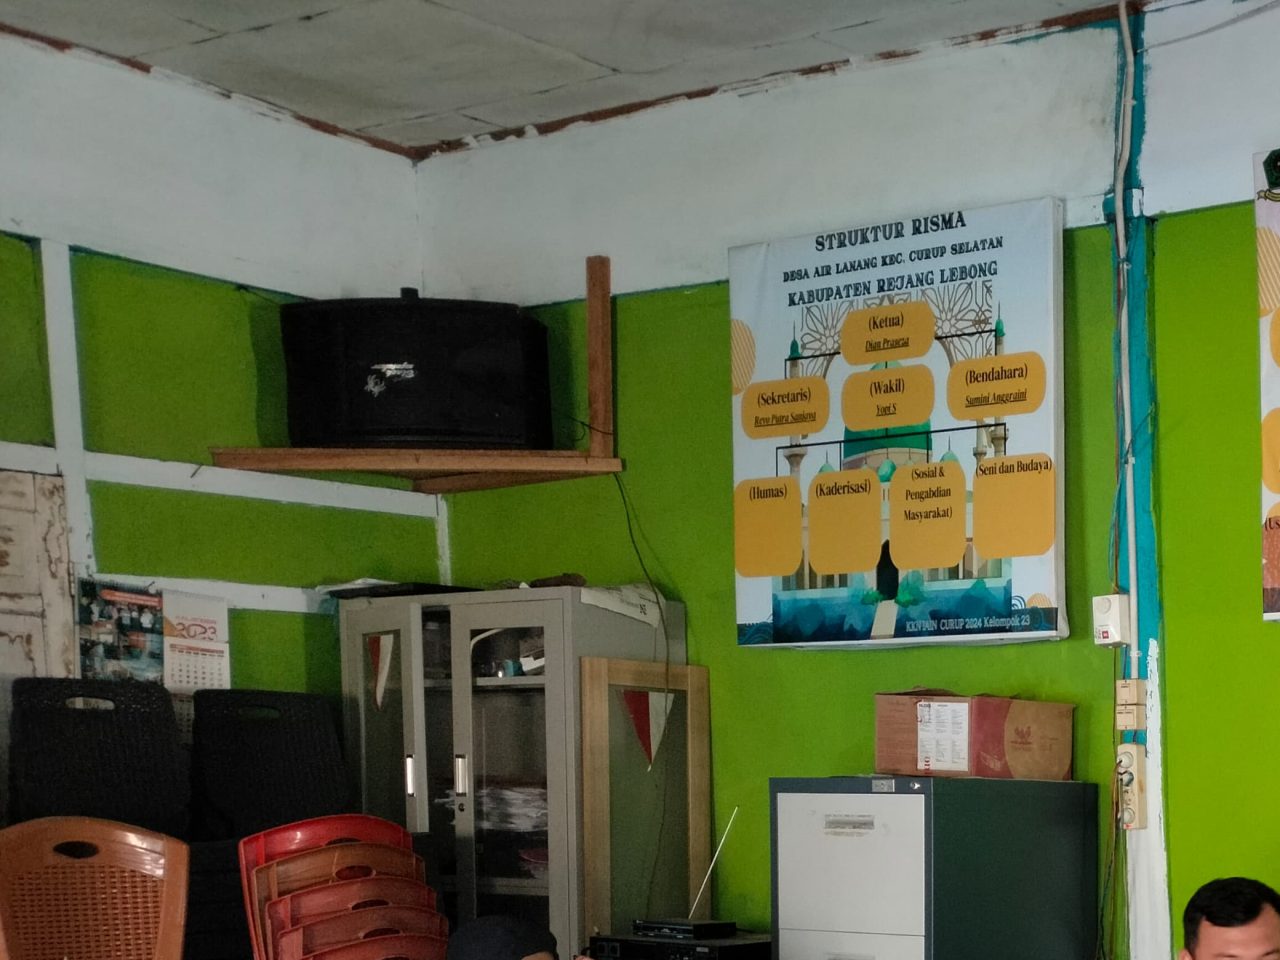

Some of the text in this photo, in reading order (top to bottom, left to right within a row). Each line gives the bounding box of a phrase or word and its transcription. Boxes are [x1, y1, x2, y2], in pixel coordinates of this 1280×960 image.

[815, 211, 966, 251] STRUKTUR RISMA
[783, 236, 1003, 282] DESA AIR LANANG KEC. CURUP SELATAN
[788, 261, 998, 306] KABUPATEN REJANG LEBONG
[868, 312, 904, 330] (Ketua)
[966, 362, 1028, 387] (Bendahara)
[869, 379, 905, 397] (Wakil)
[758, 387, 811, 408] (Sekretaris)
[911, 466, 945, 482] (Sosial &
[975, 458, 1053, 478] (Seni dan Budaya)
[749, 484, 788, 501] (Humas)
[815, 478, 871, 497] (Kaderisasi)
[905, 487, 951, 502] Pengabdian
[904, 506, 953, 524] Masyarakat)
[940, 618, 964, 630] CURUP
[984, 616, 1020, 629] Kelompok
[1021, 615, 1030, 626] 23
